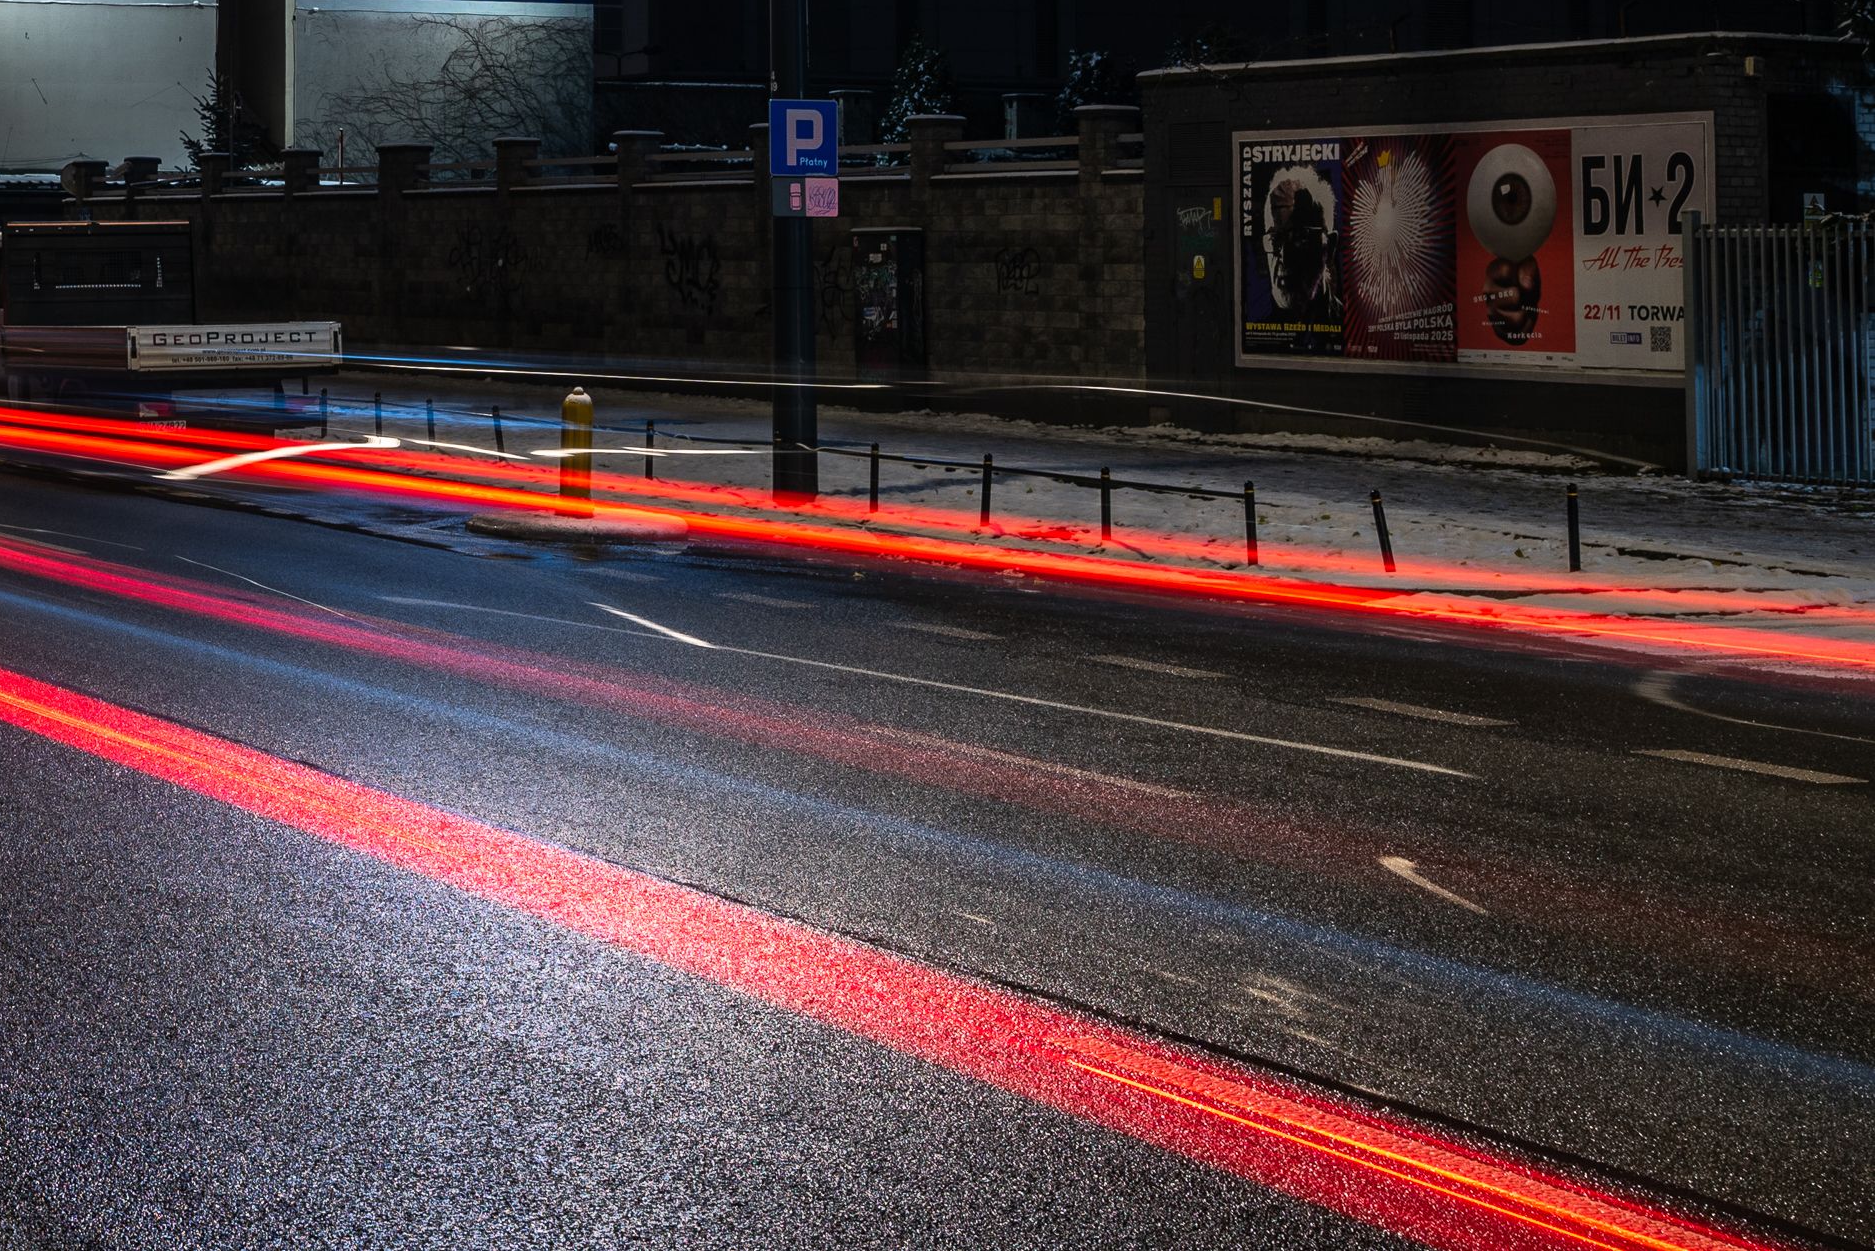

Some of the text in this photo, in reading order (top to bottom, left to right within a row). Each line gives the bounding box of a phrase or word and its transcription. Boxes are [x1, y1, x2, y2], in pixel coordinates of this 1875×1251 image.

[786, 109, 823, 166] P
[1252, 143, 1340, 163] STRYJECKI
[800, 156, 828, 168] Płatny
[1242, 146, 1253, 237] RYSZARD
[1582, 244, 1684, 270] All The Bes
[1424, 301, 1454, 315] NAGRÓD
[1584, 304, 1685, 322] 22/11 TORWA
[1245, 322, 1282, 331] WYSTAWA
[1313, 324, 1342, 333] MEDALI
[1395, 320, 1412, 331] BYŁA
[1413, 314, 1454, 330] POLSKĄ
[1400, 332, 1429, 342] listopada
[1431, 331, 1454, 341] 2025
